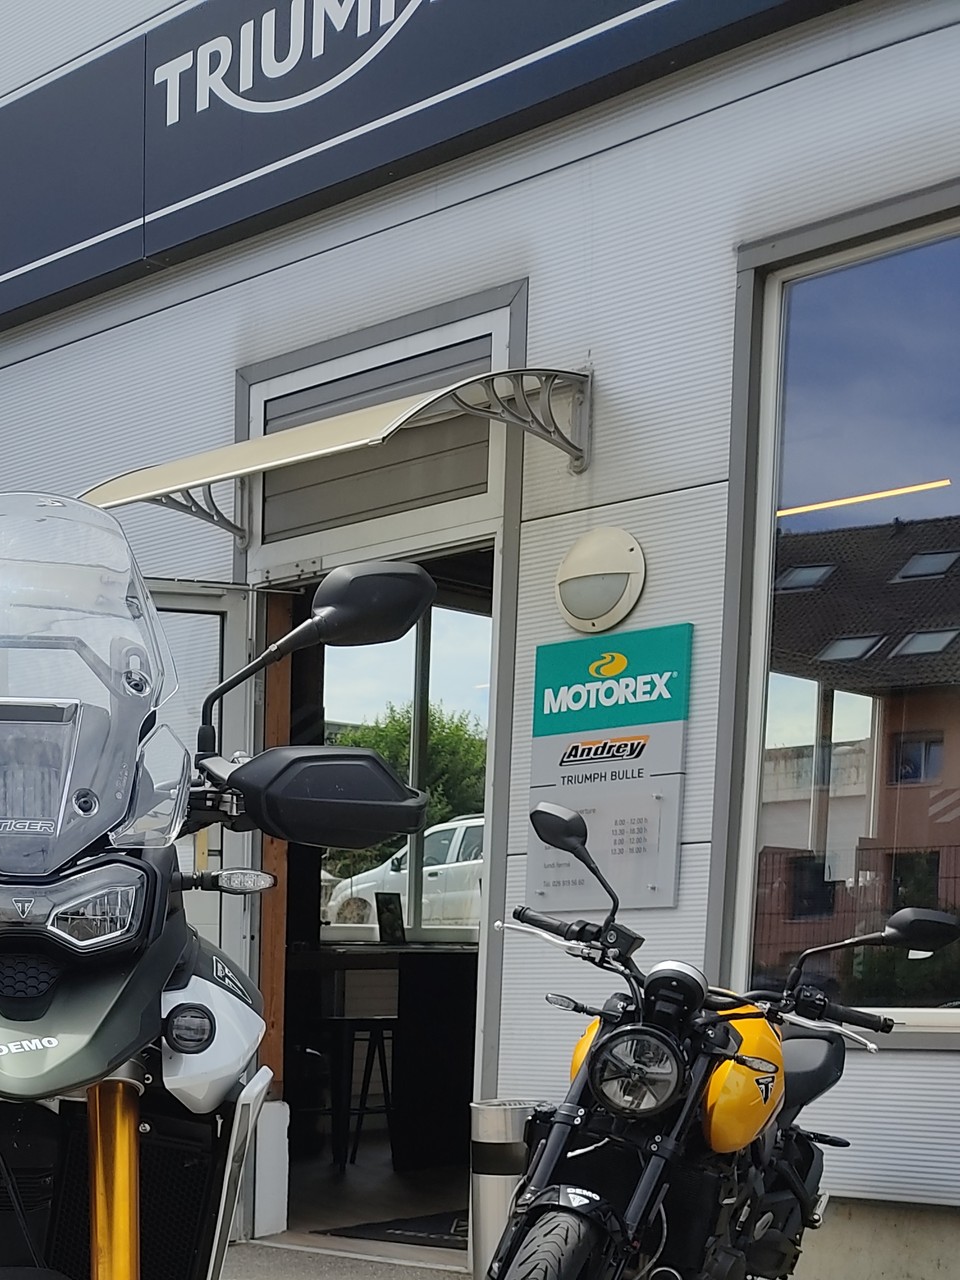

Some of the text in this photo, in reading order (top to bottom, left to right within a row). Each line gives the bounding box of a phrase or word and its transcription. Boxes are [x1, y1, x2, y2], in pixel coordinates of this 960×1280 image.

[565, 740, 644, 761] Andrey
[560, 768, 644, 786] TRIUMPH BULLE
[566, 1187, 601, 1201] DEMO
